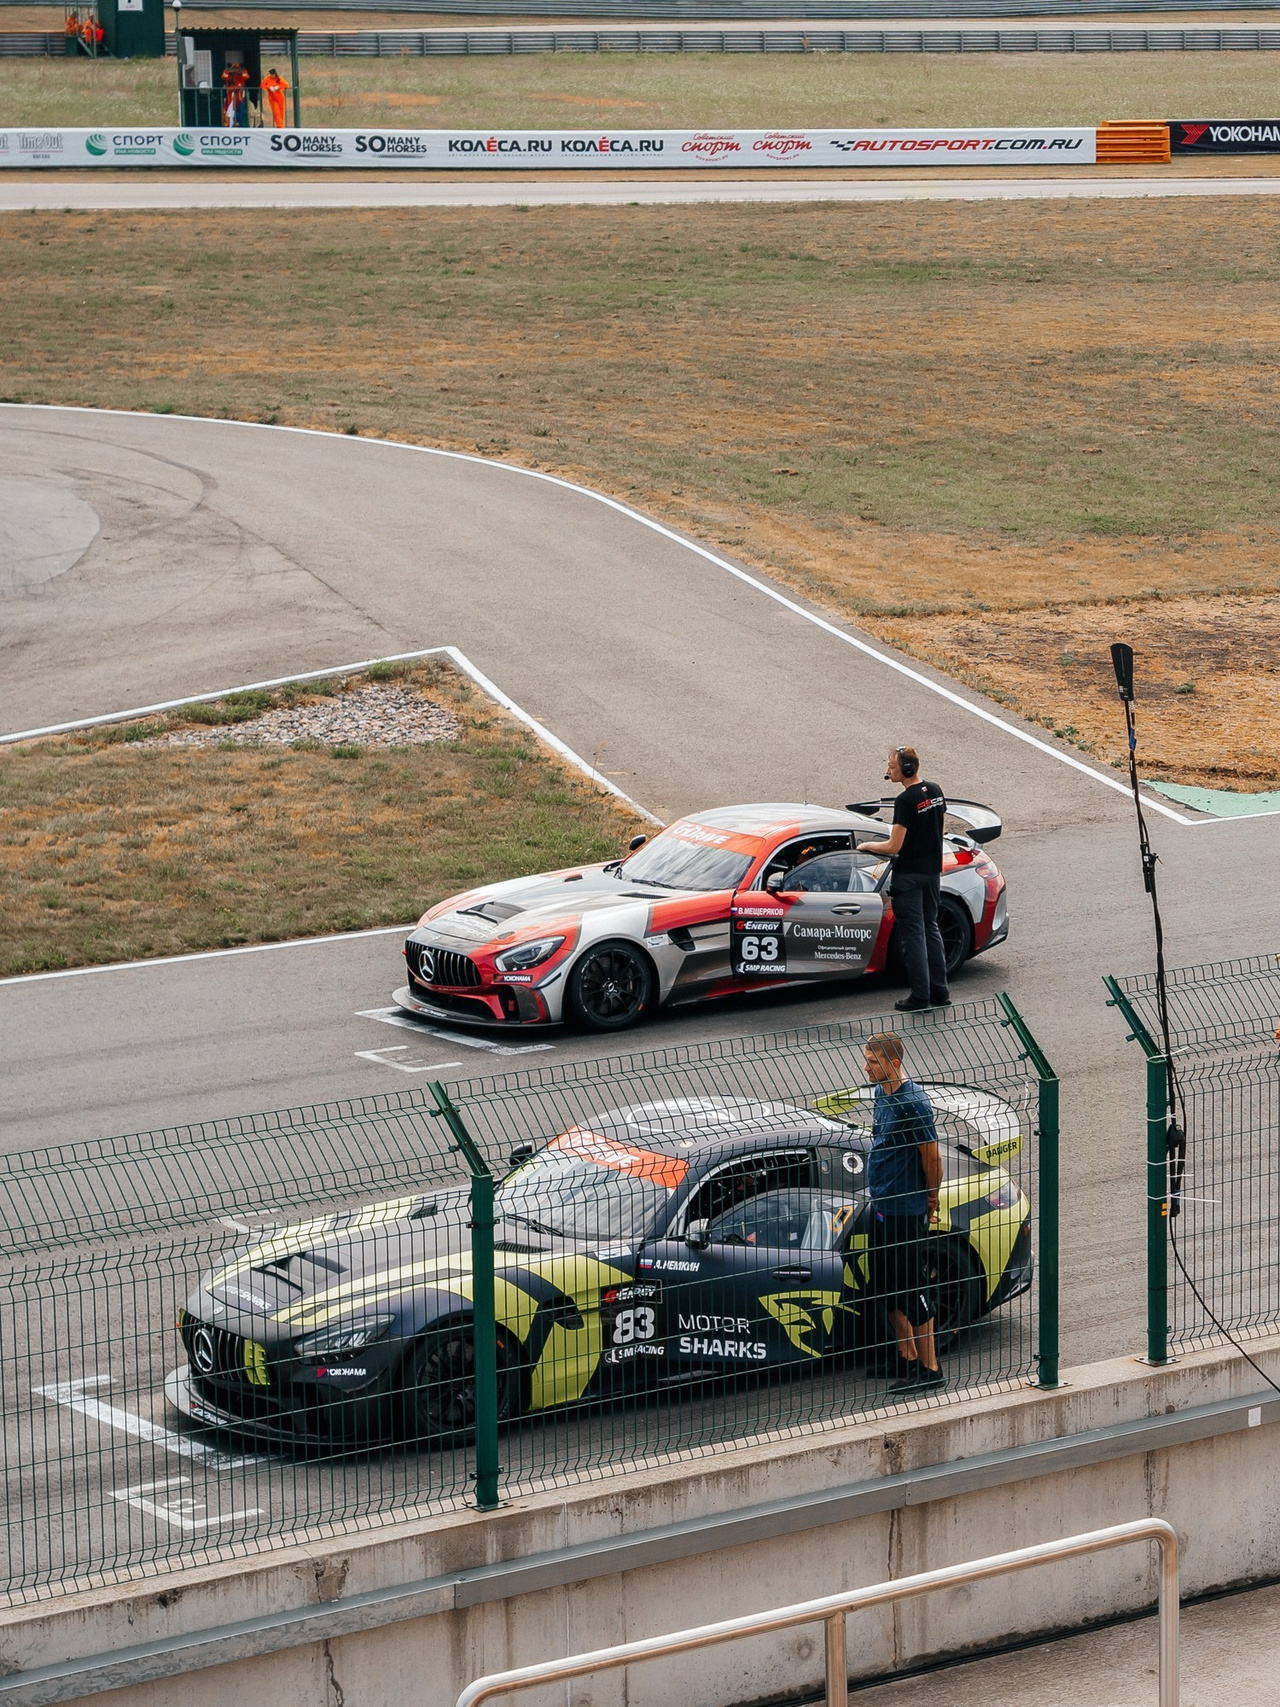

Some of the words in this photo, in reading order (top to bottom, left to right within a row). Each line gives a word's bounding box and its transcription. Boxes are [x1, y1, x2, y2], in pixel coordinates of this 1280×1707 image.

[112, 135, 164, 146] СПОРТ
[200, 135, 251, 146] СПОРТ
[270, 135, 301, 152] SO
[302, 136, 336, 144] MANY
[302, 143, 343, 152] HORSES
[355, 135, 386, 153] SO
[387, 136, 420, 145] MANY
[851, 138, 1084, 152] AUTOSPORT.COM.RU
[387, 144, 427, 153] HORSES
[738, 907, 784, 916] В.МЕЩЕРЯКОВ
[793, 924, 872, 942] Самара-Моторс
[741, 936, 779, 961] 63
[814, 951, 862, 960] Mercedes-Benz
[745, 964, 760, 972] SMP
[986, 1141, 1018, 1159] DANGER
[613, 1306, 655, 1344] 83
[678, 1313, 751, 1334] MOTOR
[679, 1336, 767, 1360] SHARKS
